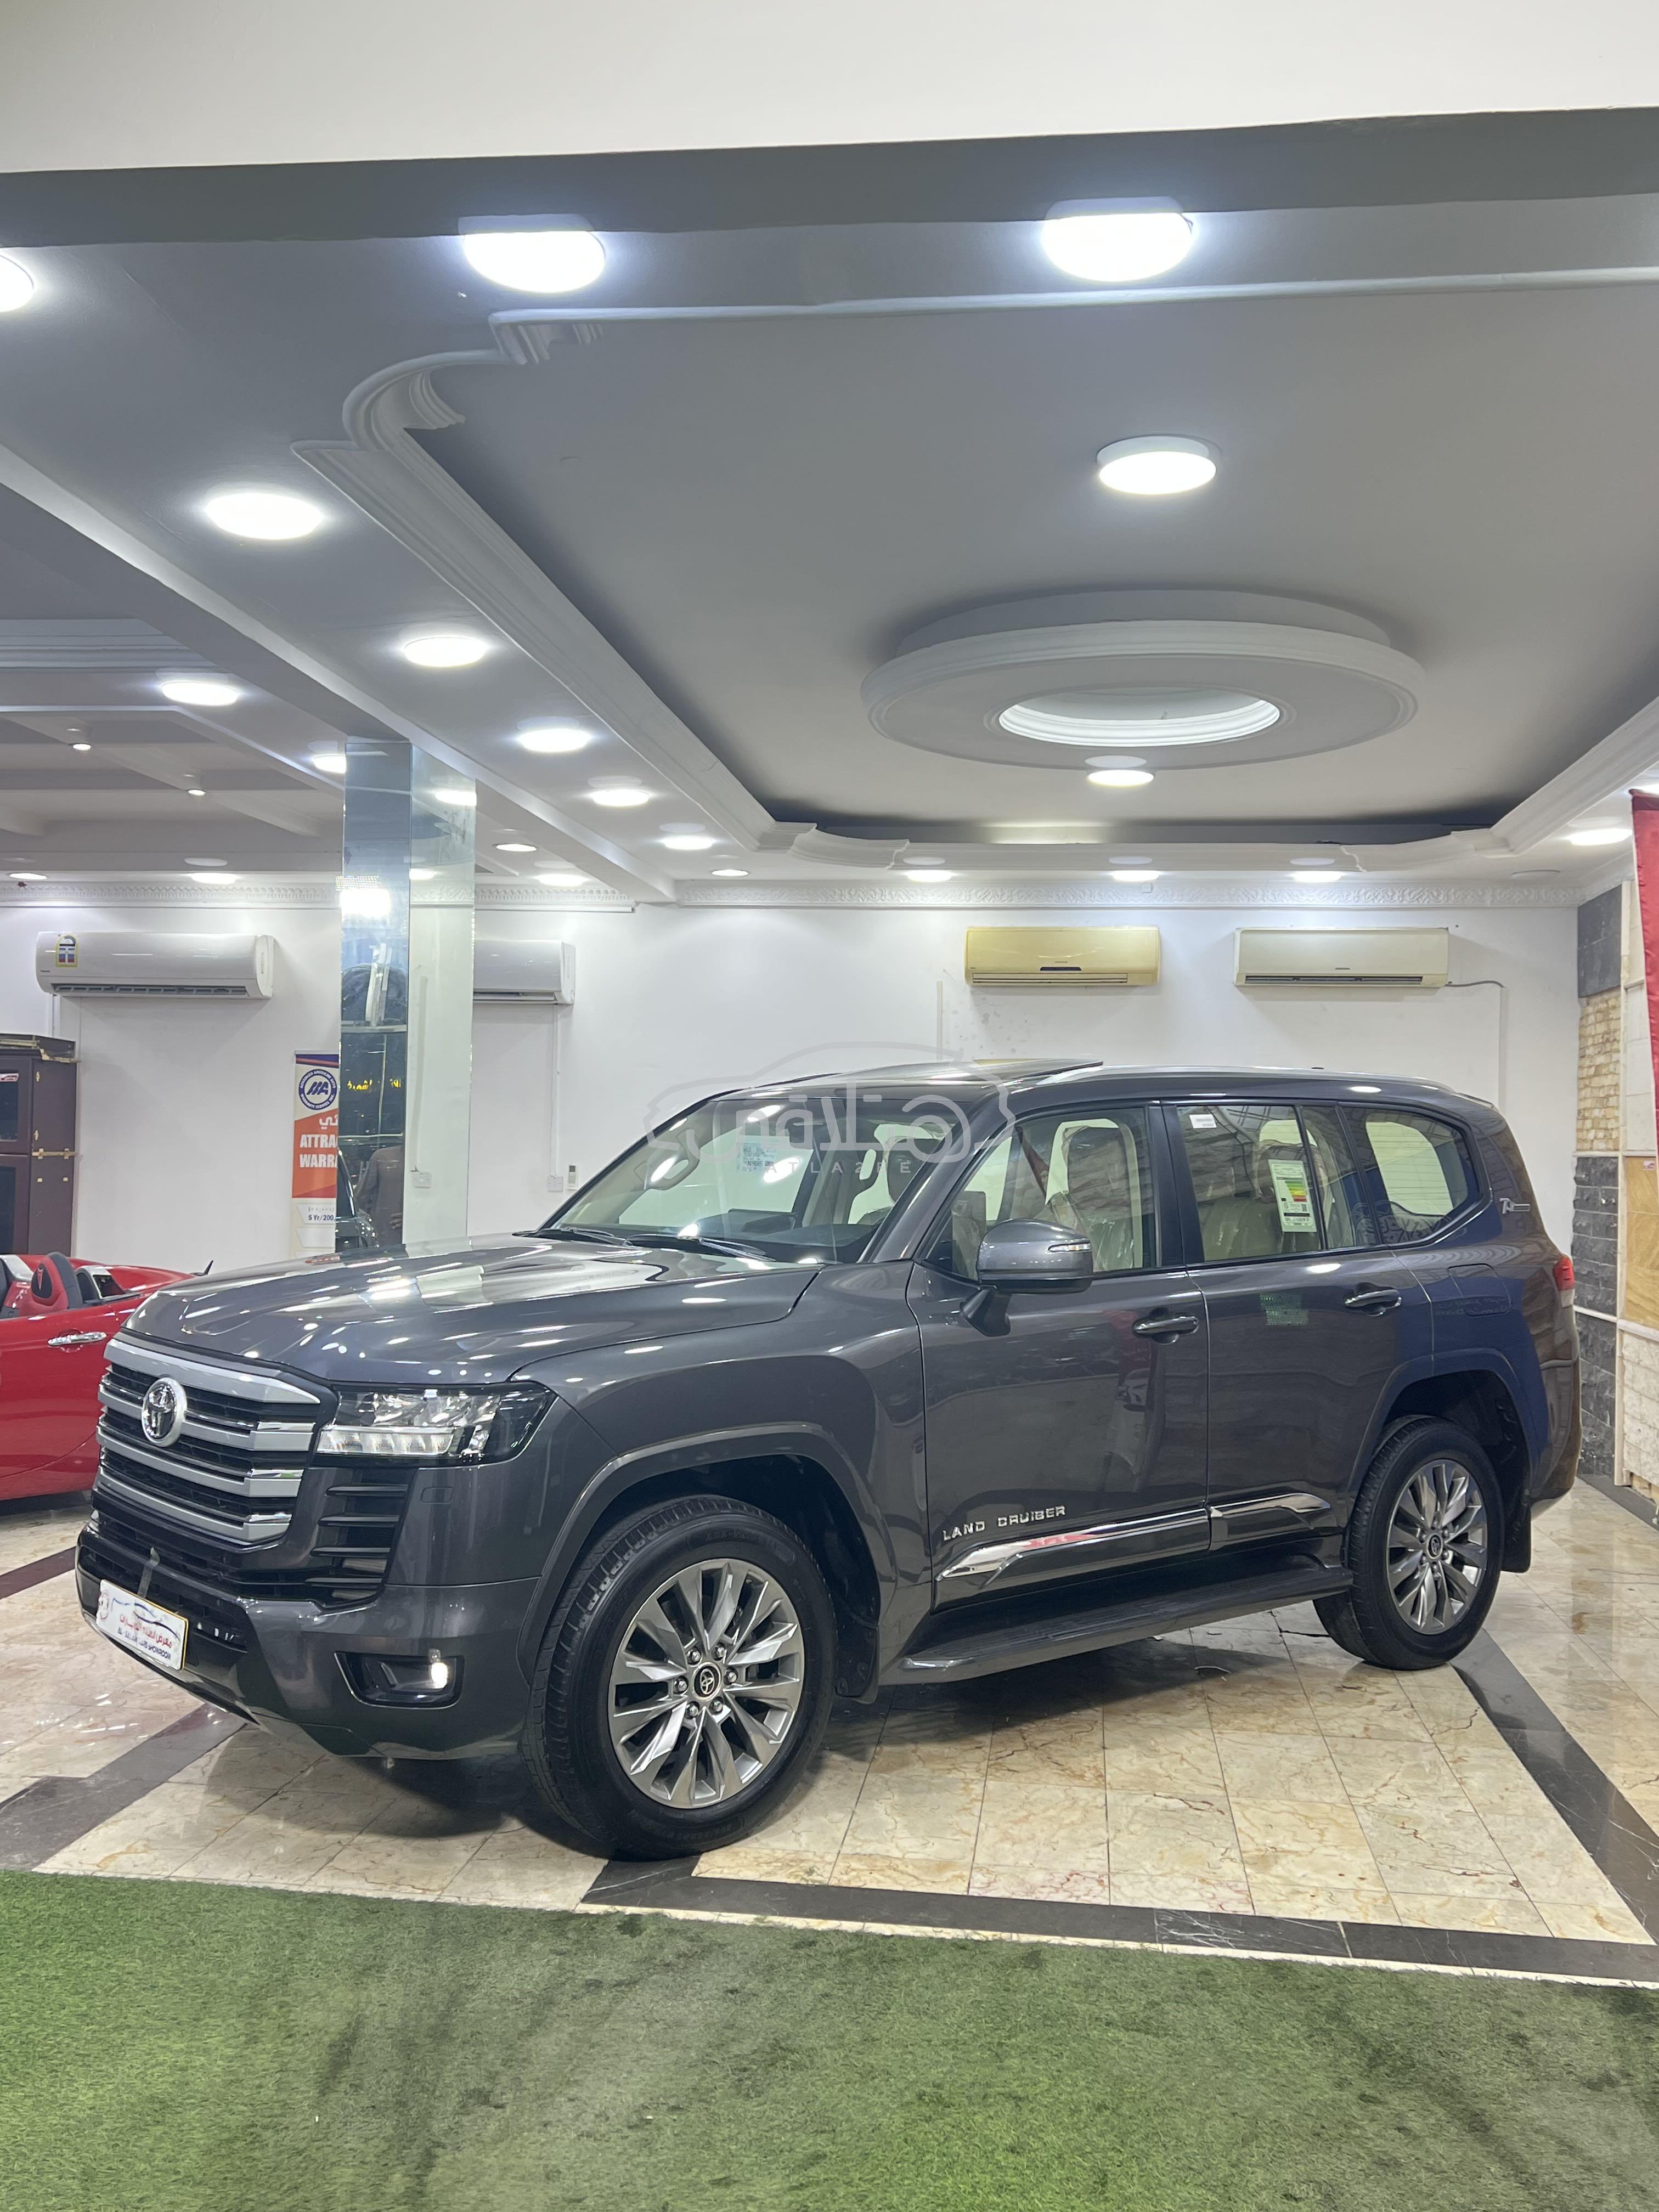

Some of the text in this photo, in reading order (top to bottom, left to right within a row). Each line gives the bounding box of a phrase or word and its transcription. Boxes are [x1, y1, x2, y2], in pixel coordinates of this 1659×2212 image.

[300, 1134, 338, 1148] ATTRA
[943, 1505, 1066, 1541] LAND CRUISER
